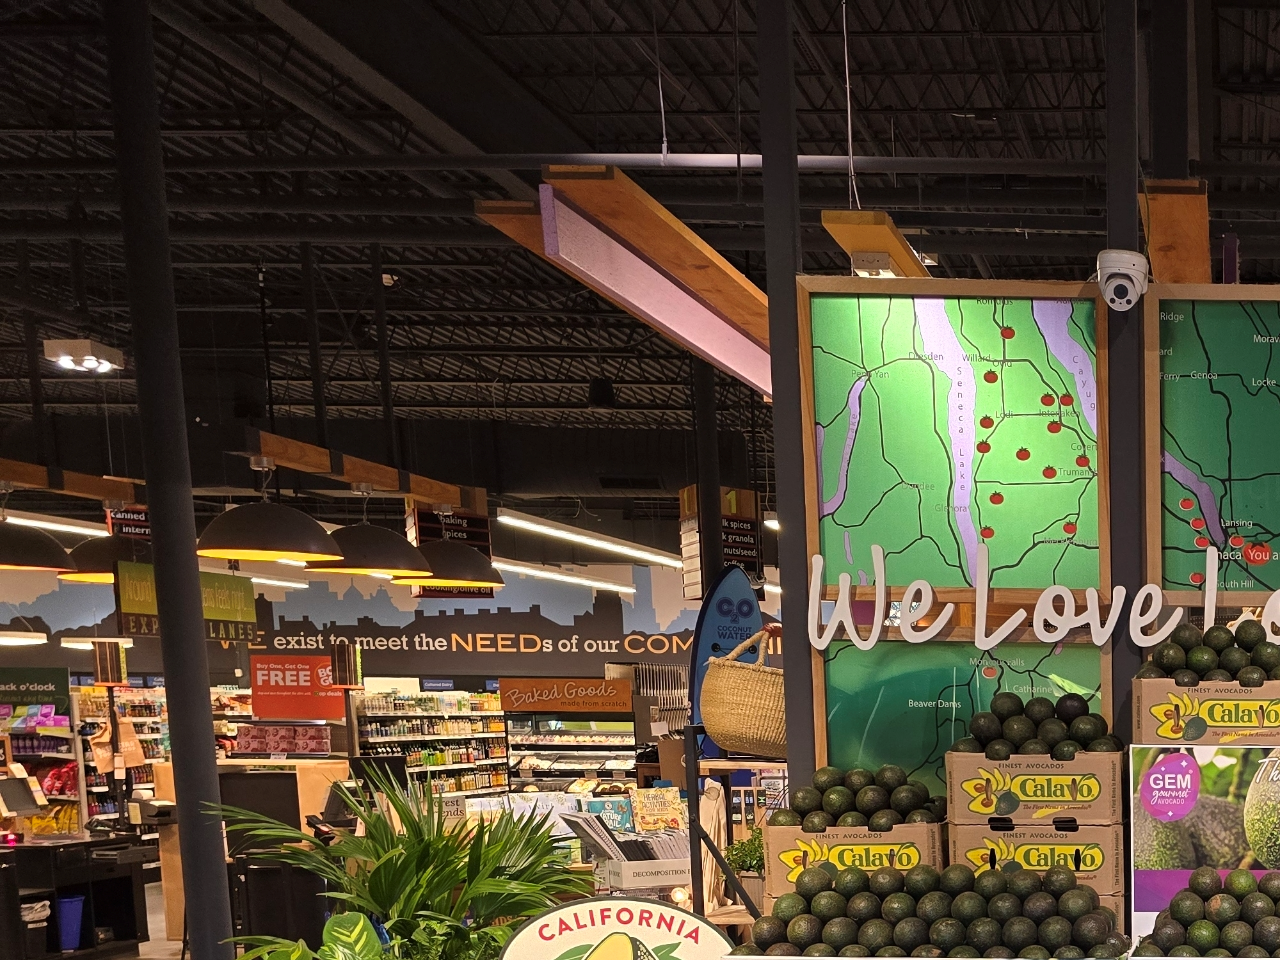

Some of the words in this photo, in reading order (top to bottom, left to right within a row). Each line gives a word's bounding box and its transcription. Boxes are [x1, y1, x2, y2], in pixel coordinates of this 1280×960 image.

[1190, 371, 1218, 379] Genoa
[1252, 378, 1276, 387] Locke
[730, 521, 751, 531] spices
[1221, 519, 1252, 528] Lansing
[728, 534, 754, 544] granola
[1248, 550, 1269, 560] You
[808, 544, 955, 650] We
[975, 542, 1183, 650] Love
[210, 622, 253, 639] LANES
[274, 632, 324, 650] exist
[355, 634, 409, 650] meet
[413, 632, 448, 650] the
[451, 633, 552, 652] NEEDs
[558, 634, 579, 652] of
[584, 639, 619, 652] our
[257, 671, 310, 685] FREE
[505, 685, 562, 708] Baked
[564, 681, 617, 699] Goods
[1150, 774, 1191, 788] GEM
[1151, 788, 1191, 804] gourmet
[633, 869, 686, 877] DECOMPOSITION
[538, 908, 699, 944] CALIFORNIA
